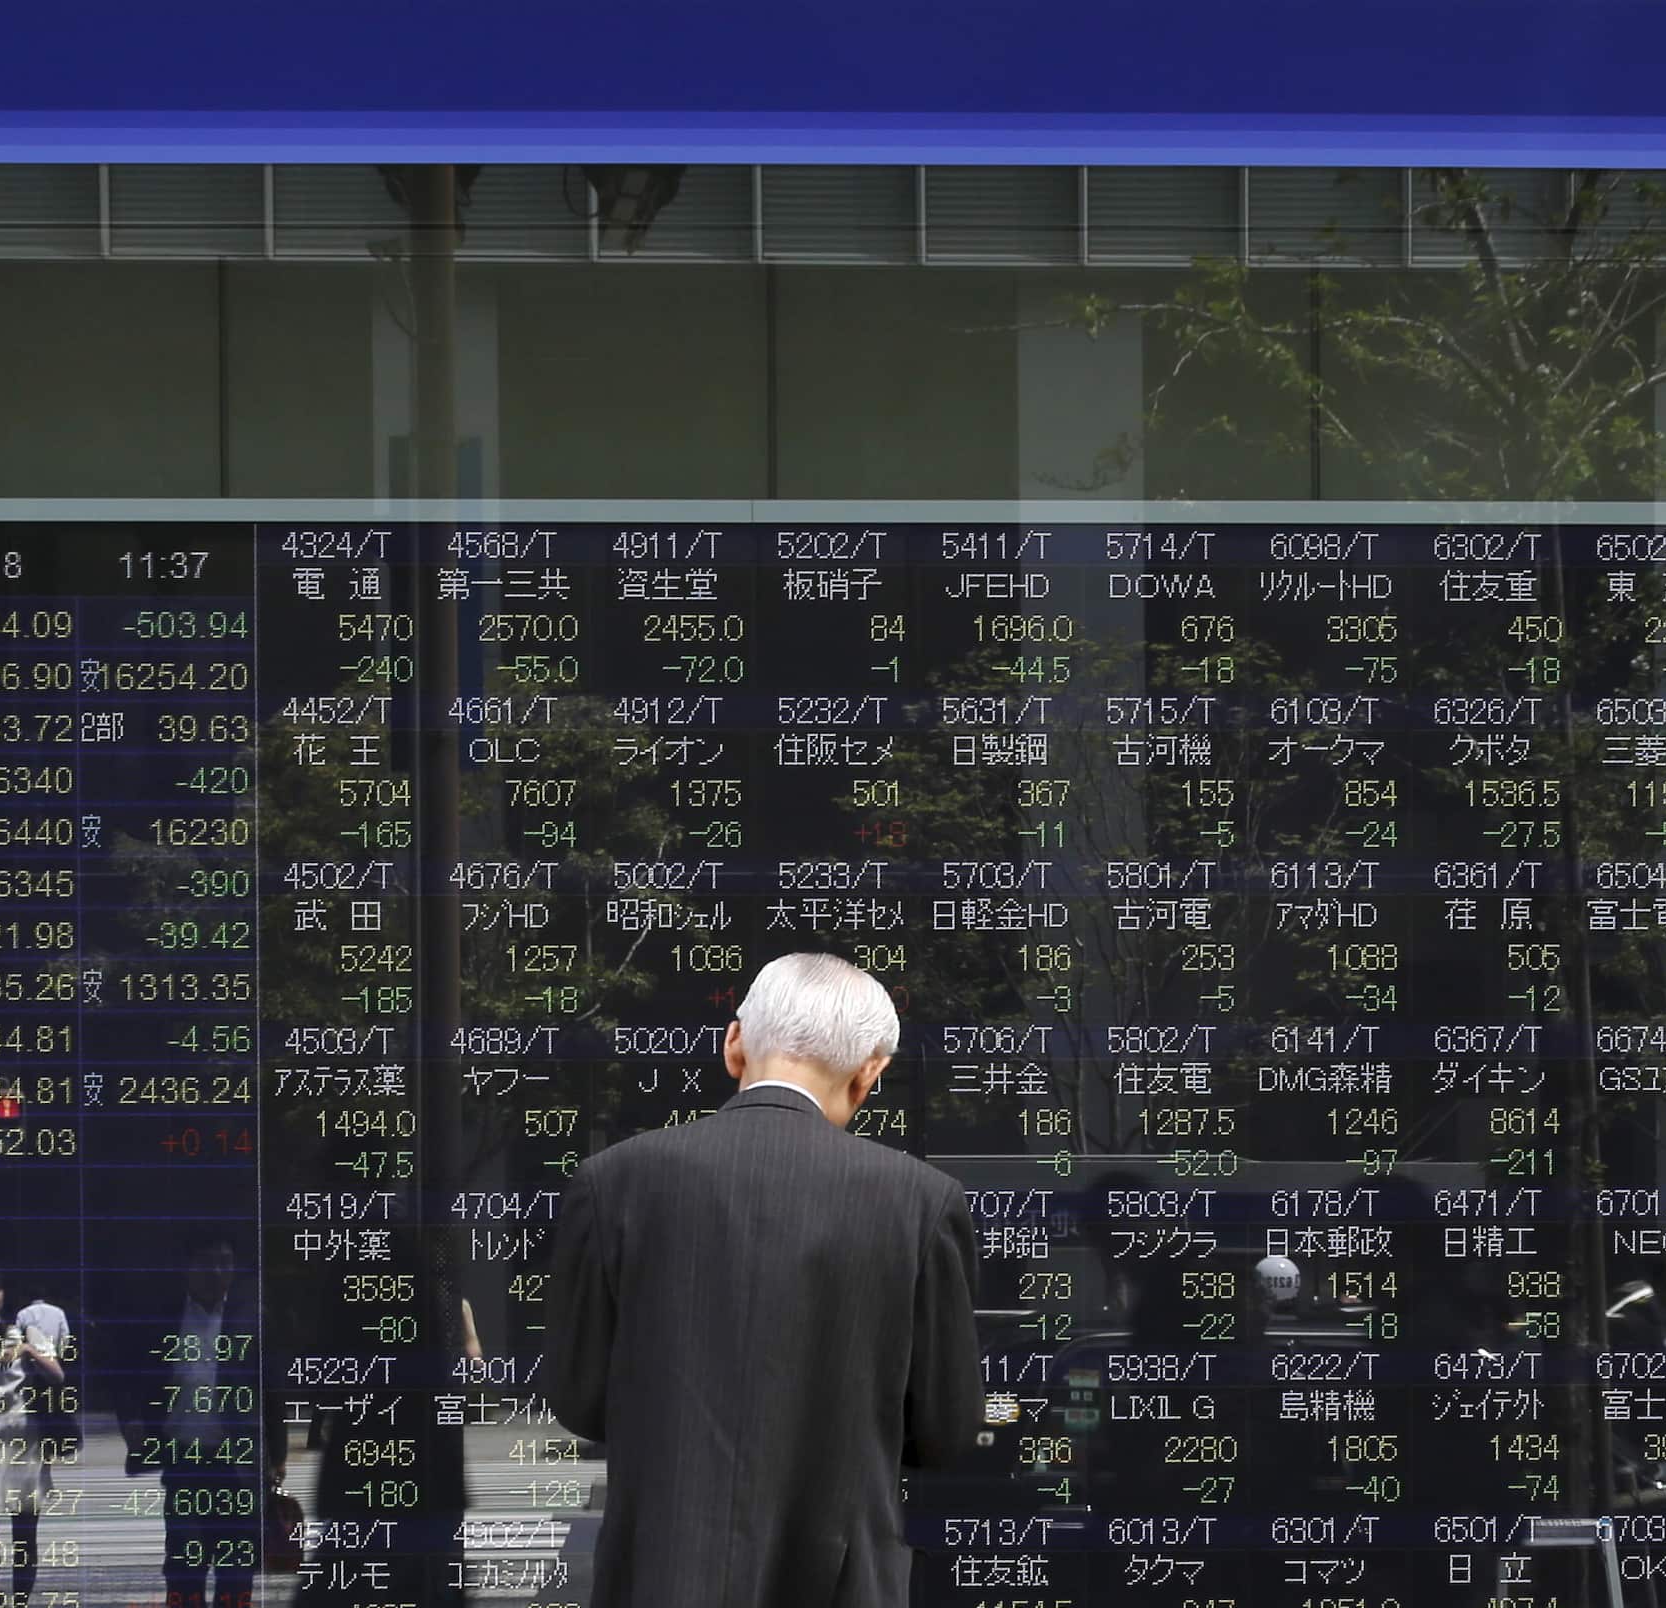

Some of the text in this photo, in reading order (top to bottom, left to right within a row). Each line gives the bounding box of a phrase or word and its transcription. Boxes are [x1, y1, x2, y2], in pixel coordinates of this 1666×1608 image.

[281, 528, 392, 559] 4324/T
[447, 528, 558, 559] 4568/T
[612, 529, 723, 560] 4911/T
[777, 529, 888, 560] 5202/T
[942, 529, 1052, 560] 5411/T
[1106, 530, 1216, 561] 5714/T
[1270, 530, 1380, 561] 6098/T
[1433, 530, 1542, 561] 6302/T
[118, 551, 211, 579] 11:37
[436, 567, 571, 600] 第一三共
[617, 567, 718, 601] 資生堂
[782, 567, 883, 601] 板硝子
[945, 573, 1050, 599] JFEHD
[1109, 573, 1216, 599] DOWA
[1438, 569, 1538, 602] 住友重
[122, 611, 249, 639] -503.94
[339, 613, 414, 642] 5470
[478, 614, 579, 642] 2570.0
[644, 614, 744, 642] 2455.0
[870, 614, 906, 642] 84
[973, 614, 1073, 642] 1696.0
[1181, 615, 1235, 643] 676
[1326, 614, 1398, 643] 3305
[1507, 615, 1563, 643] 450
[339, 655, 414, 683] -240
[496, 655, 579, 683] -55.0
[662, 655, 744, 683] -72.0
[870, 656, 898, 683] -1
[991, 656, 1070, 683] -44.5
[1180, 656, 1234, 684] -18
[1344, 656, 1398, 684] -75
[1508, 656, 1561, 684] -18
[282, 694, 393, 725] 4452/T
[448, 694, 558, 725] 4661/T
[612, 694, 724, 725] 4912/T
[778, 694, 888, 725] 5232/T
[942, 694, 1053, 725] 5631/T
[1106, 694, 1217, 725] 5715/T
[1433, 695, 1543, 725] 6326/T
[158, 714, 250, 743] 39.63
[468, 737, 541, 763] OLC
[612, 735, 724, 766] ライオン
[953, 728, 1048, 766] 日製鋼
[174, 766, 249, 794] -420
[149, 818, 249, 846] 16230
[176, 869, 250, 898] -390
[283, 859, 394, 890] 4502/T
[448, 859, 559, 890] 4676/T
[778, 859, 889, 890] 5233/T
[1107, 858, 1217, 889] 5801/T
[1270, 859, 1380, 889] 6113/T
[1434, 859, 1543, 889] 6361/T
[1112, 897, 1212, 930] 古河電
[146, 921, 251, 950] -39.42
[120, 973, 252, 1001] 1313.35
[166, 1025, 251, 1053] -4.56
[450, 1024, 560, 1055] 4689/T
[614, 1020, 725, 1055] 5020/T
[943, 1024, 1054, 1054] 5706/T
[1107, 1023, 1217, 1054] 5802/T
[1271, 1023, 1381, 1054] 6141/T
[1434, 1023, 1543, 1053] 6367/T
[118, 1076, 252, 1105] 2436.24
[462, 1065, 550, 1096] ヤフー
[948, 1062, 1049, 1095] 三井金
[1113, 1062, 1212, 1095] 住友電
[1258, 1061, 1393, 1094] DMG森精
[285, 1189, 397, 1221] 4519/T
[450, 1189, 561, 1220] 4704/T
[1271, 1187, 1380, 1217] 6178/T
[1434, 1186, 1543, 1217] 6471/T
[293, 1228, 392, 1261] 中外薬
[1266, 1225, 1393, 1258] 日本郵政
[149, 1334, 254, 1362] -28.97
[287, 1354, 397, 1385] 4523/T
[1108, 1351, 1218, 1382] 5938/T
[1271, 1351, 1381, 1381] 6222/T
[149, 1385, 254, 1413] -7.670
[1279, 1388, 1376, 1422] 島精機
[130, 1437, 254, 1465] -214.42
[108, 1488, 254, 1518] -42.6039
[288, 1518, 398, 1551] 4543/T
[944, 1516, 1054, 1546] 5713/T
[1108, 1515, 1218, 1545] 6013/T
[1271, 1513, 1380, 1544] 6301/T
[1434, 1513, 1543, 1545] 6501/T
[171, 1540, 255, 1569] -9.23
[296, 1560, 391, 1590] テルモ
[950, 1554, 1049, 1587] 住友鉱
[1284, 1557, 1365, 1585] コマツ
